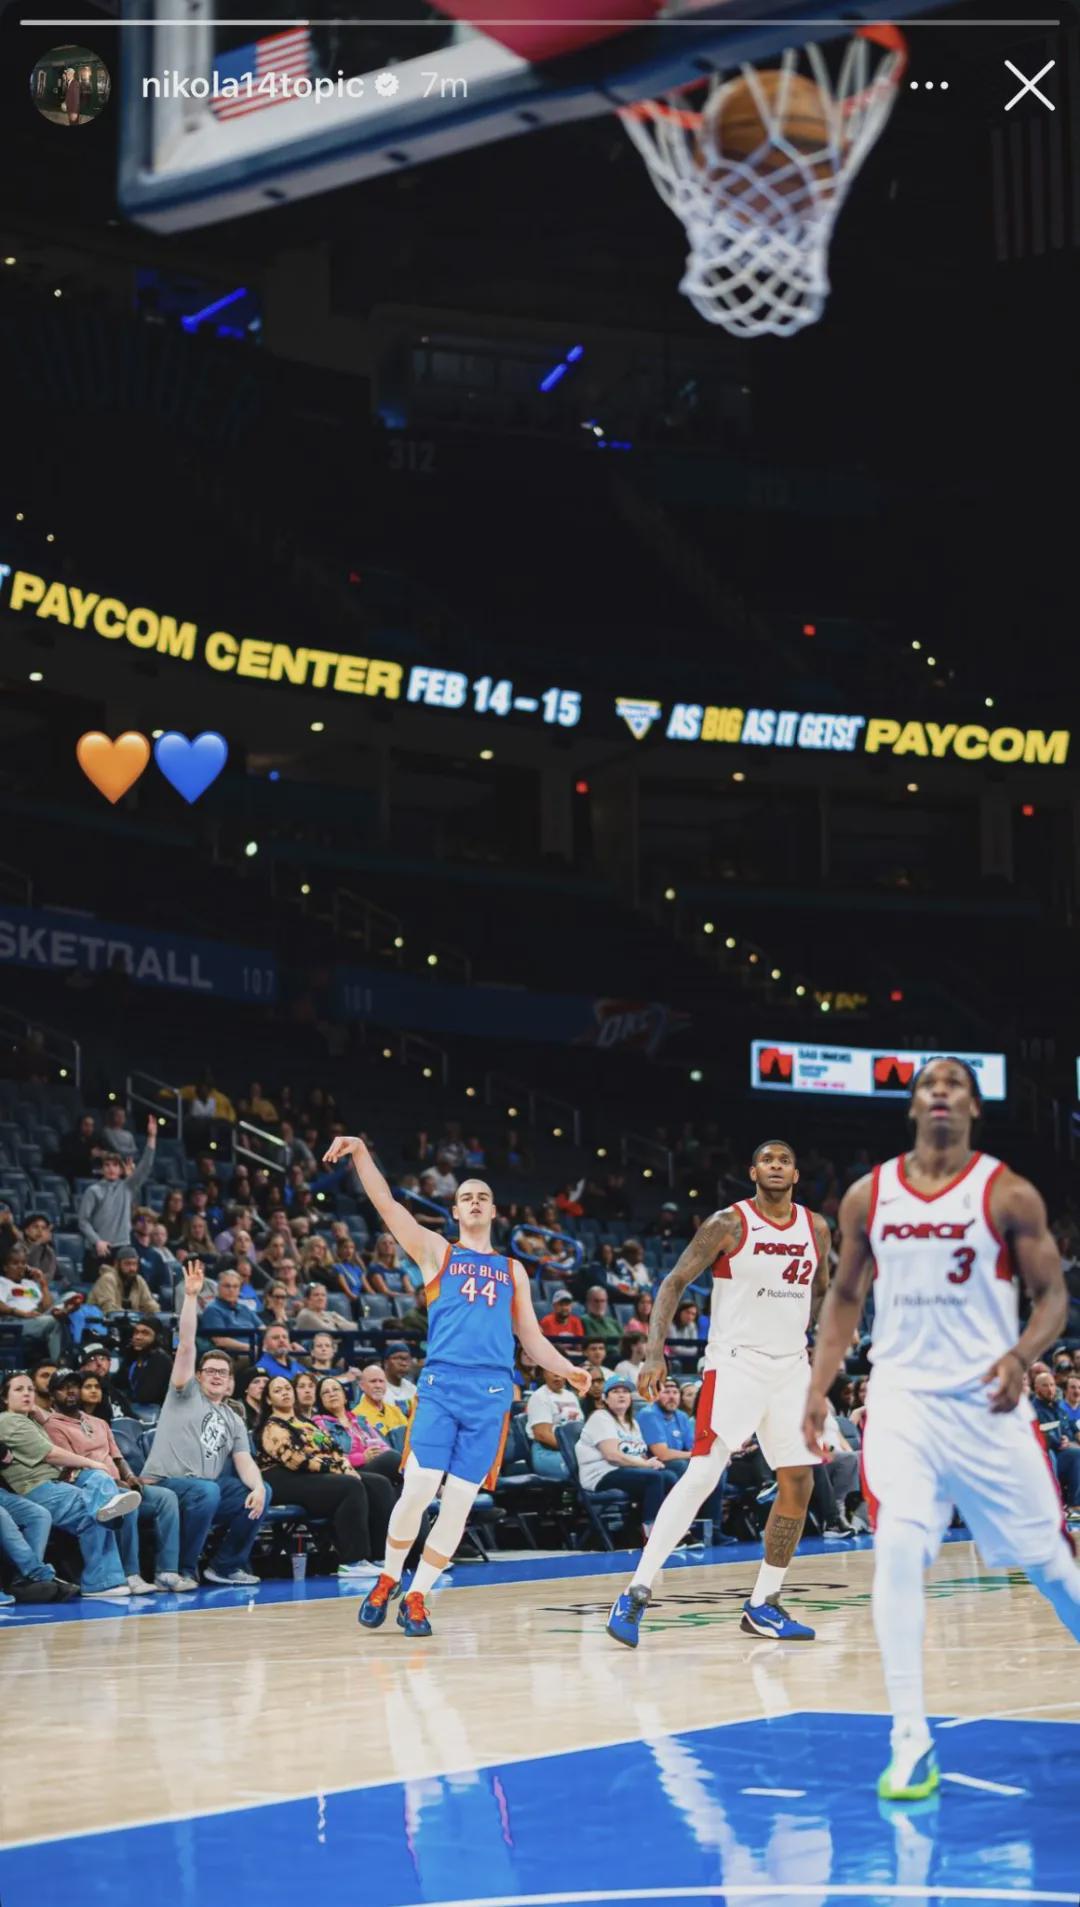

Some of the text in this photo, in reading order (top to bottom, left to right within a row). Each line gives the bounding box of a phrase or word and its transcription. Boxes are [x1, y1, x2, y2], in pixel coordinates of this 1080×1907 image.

[10, 571, 198, 661] PAYCOM
[205, 631, 403, 700] CENTER
[407, 666, 467, 708] FEB
[666, 704, 701, 740] AS
[701, 706, 744, 743] BIG
[742, 709, 775, 746] AS
[775, 711, 799, 747] IT
[864, 718, 1070, 765] PAYCOM
[449, 1262, 511, 1286] OKC BLUE
[782, 1259, 813, 1286] 42
[947, 1246, 976, 1286] 3
[460, 1277, 497, 1307] 44
